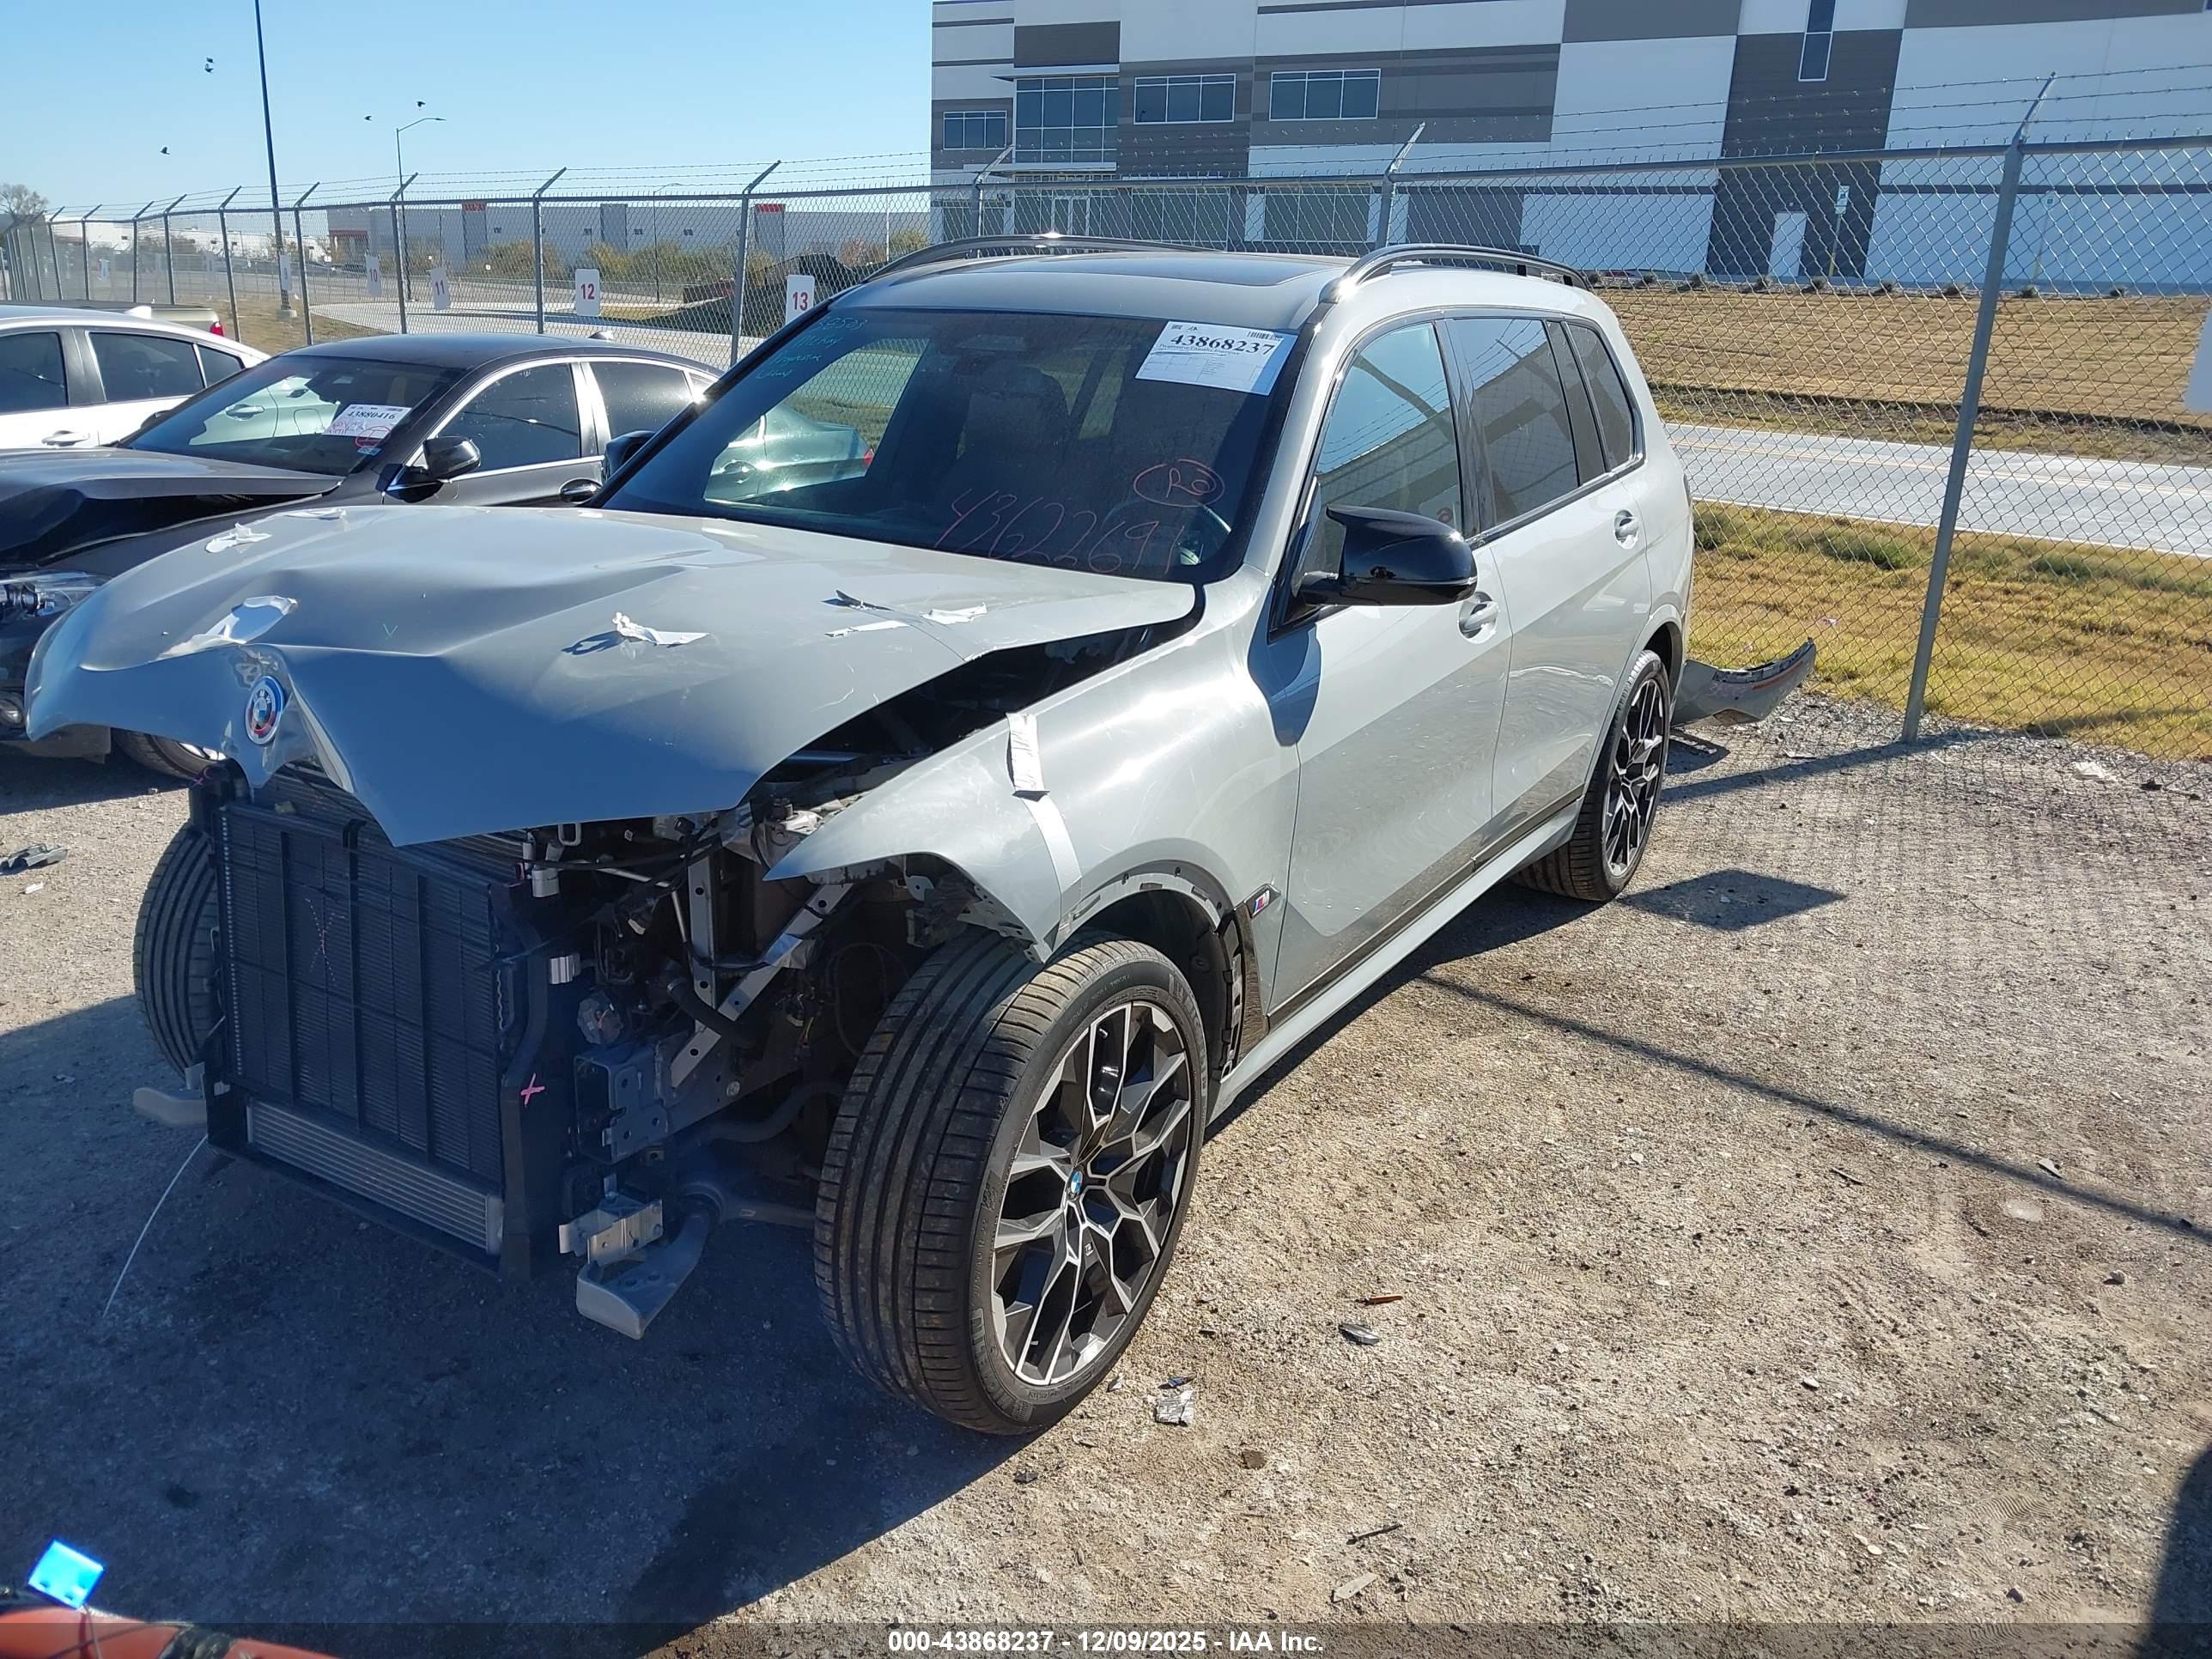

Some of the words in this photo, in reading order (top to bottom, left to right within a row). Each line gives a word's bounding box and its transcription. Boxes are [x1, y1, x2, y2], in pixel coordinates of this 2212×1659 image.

[369, 268, 378, 283] 10
[434, 280, 446, 295] 11
[580, 283, 595, 300] 12
[792, 291, 809, 311] 13
[1170, 334, 1275, 356] 43868237
[347, 410, 397, 420] 43880416
